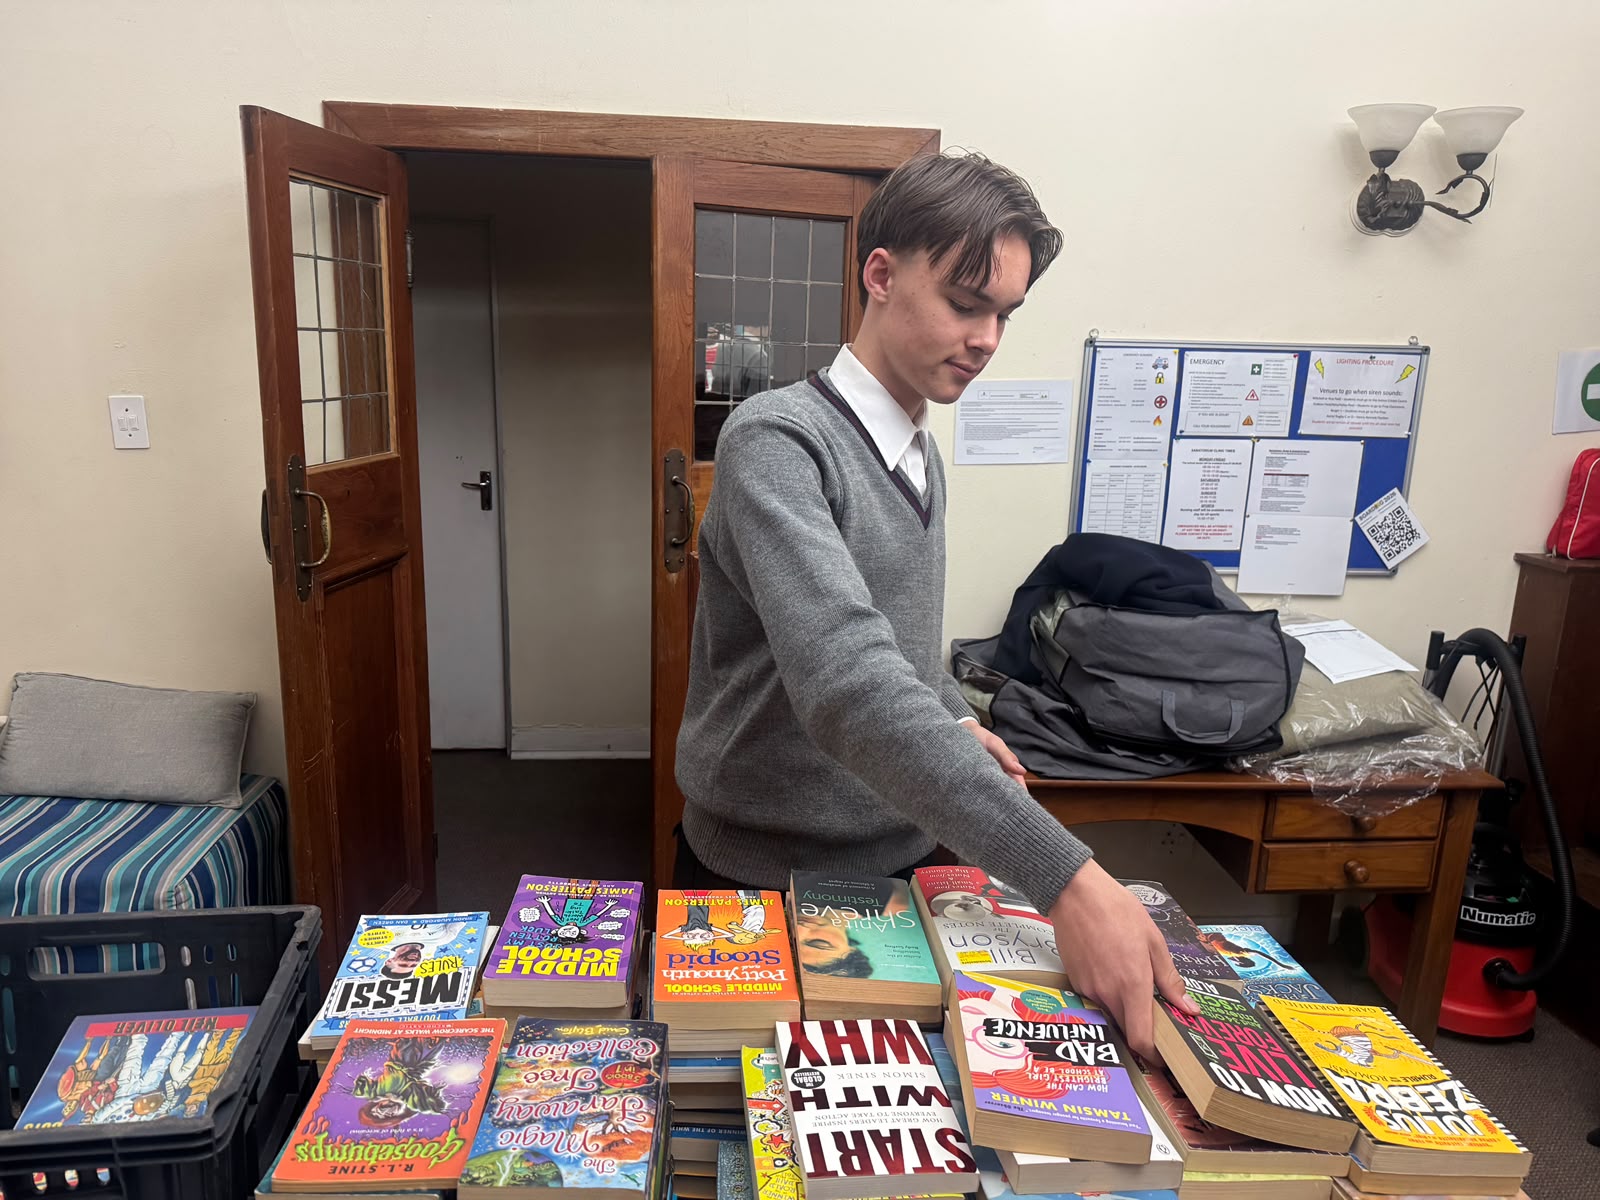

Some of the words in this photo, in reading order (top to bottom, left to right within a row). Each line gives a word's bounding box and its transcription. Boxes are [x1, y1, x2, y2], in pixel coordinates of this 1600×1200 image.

[1336, 358, 1360, 366] LIGHTING
[1361, 358, 1394, 366] PROCEDURE
[1359, 500, 1384, 521] BOARDG
[526, 883, 592, 894] PATTERSON
[665, 898, 731, 906] PATTERSON
[737, 898, 774, 906] JAMES
[803, 890, 884, 907] Testimony
[800, 902, 916, 928] Shreve
[1460, 905, 1536, 927] Numatic
[520, 925, 551, 934] LUCK
[831, 918, 890, 933] Anita
[988, 922, 1054, 936] COMPLETE
[509, 931, 558, 942] ROTTEN
[528, 940, 562, 949] JUST
[502, 945, 622, 962] SCHOOL
[666, 948, 780, 969] Stoopid
[990, 948, 1036, 964] Bill
[1169, 952, 1228, 967] HARRY
[419, 956, 458, 974] RULES
[496, 959, 618, 976] MIDDLE
[1200, 968, 1220, 976] J.K.
[662, 966, 788, 981] Pottymouth
[336, 972, 462, 1012] MESSI
[664, 983, 722, 993] SCHOOL
[726, 982, 782, 992] MIDDLE
[1179, 975, 1219, 994] ALOK
[1242, 983, 1320, 1000] JACKS
[1186, 990, 1232, 1010] SCIE
[1199, 1004, 1258, 1023] Interesti
[1200, 1010, 1225, 1020] Othe
[113, 1019, 177, 1035] OLIVER
[181, 1016, 219, 1032] NEIL
[598, 1024, 629, 1035] Enid
[990, 1018, 1104, 1041] INFLUENCE
[1163, 1002, 1285, 1052] FOREVER
[516, 1039, 657, 1061] Collection
[785, 1019, 933, 1068] WHY
[1055, 1039, 1120, 1066] BAD
[616, 1065, 621, 1073] 1
[624, 1065, 636, 1073] in
[1204, 1035, 1316, 1088] LIVE
[523, 1067, 597, 1091] Tree
[635, 1074, 641, 1082] 3
[836, 1072, 876, 1080] SINEK
[883, 1071, 926, 1079] SIMON
[1025, 1072, 1050, 1081] GIRL
[1053, 1075, 1106, 1084] BRIGHTEST
[1093, 1068, 1104, 1076] AT
[1400, 1074, 1437, 1083] RUMBLE
[1046, 1082, 1063, 1090] THE
[1065, 1083, 1084, 1091] CAN
[1086, 1084, 1108, 1093] HOW
[1208, 1061, 1263, 1100] TO
[789, 1086, 951, 1111] WITH
[1258, 1078, 1342, 1117] HOW
[1324, 1068, 1477, 1113] ZEBRA
[990, 1091, 1057, 1110] WINTER
[495, 1096, 646, 1123] Faraway
[1063, 1104, 1131, 1121] TAMSIN
[812, 1119, 847, 1127] INSPIRE
[1375, 1107, 1484, 1137] JULIUS
[295, 1127, 464, 1169] Goosebumps
[499, 1126, 599, 1154] Magic
[806, 1128, 976, 1178] START
[583, 1158, 615, 1175] The
[769, 1184, 795, 1193] ROALD
